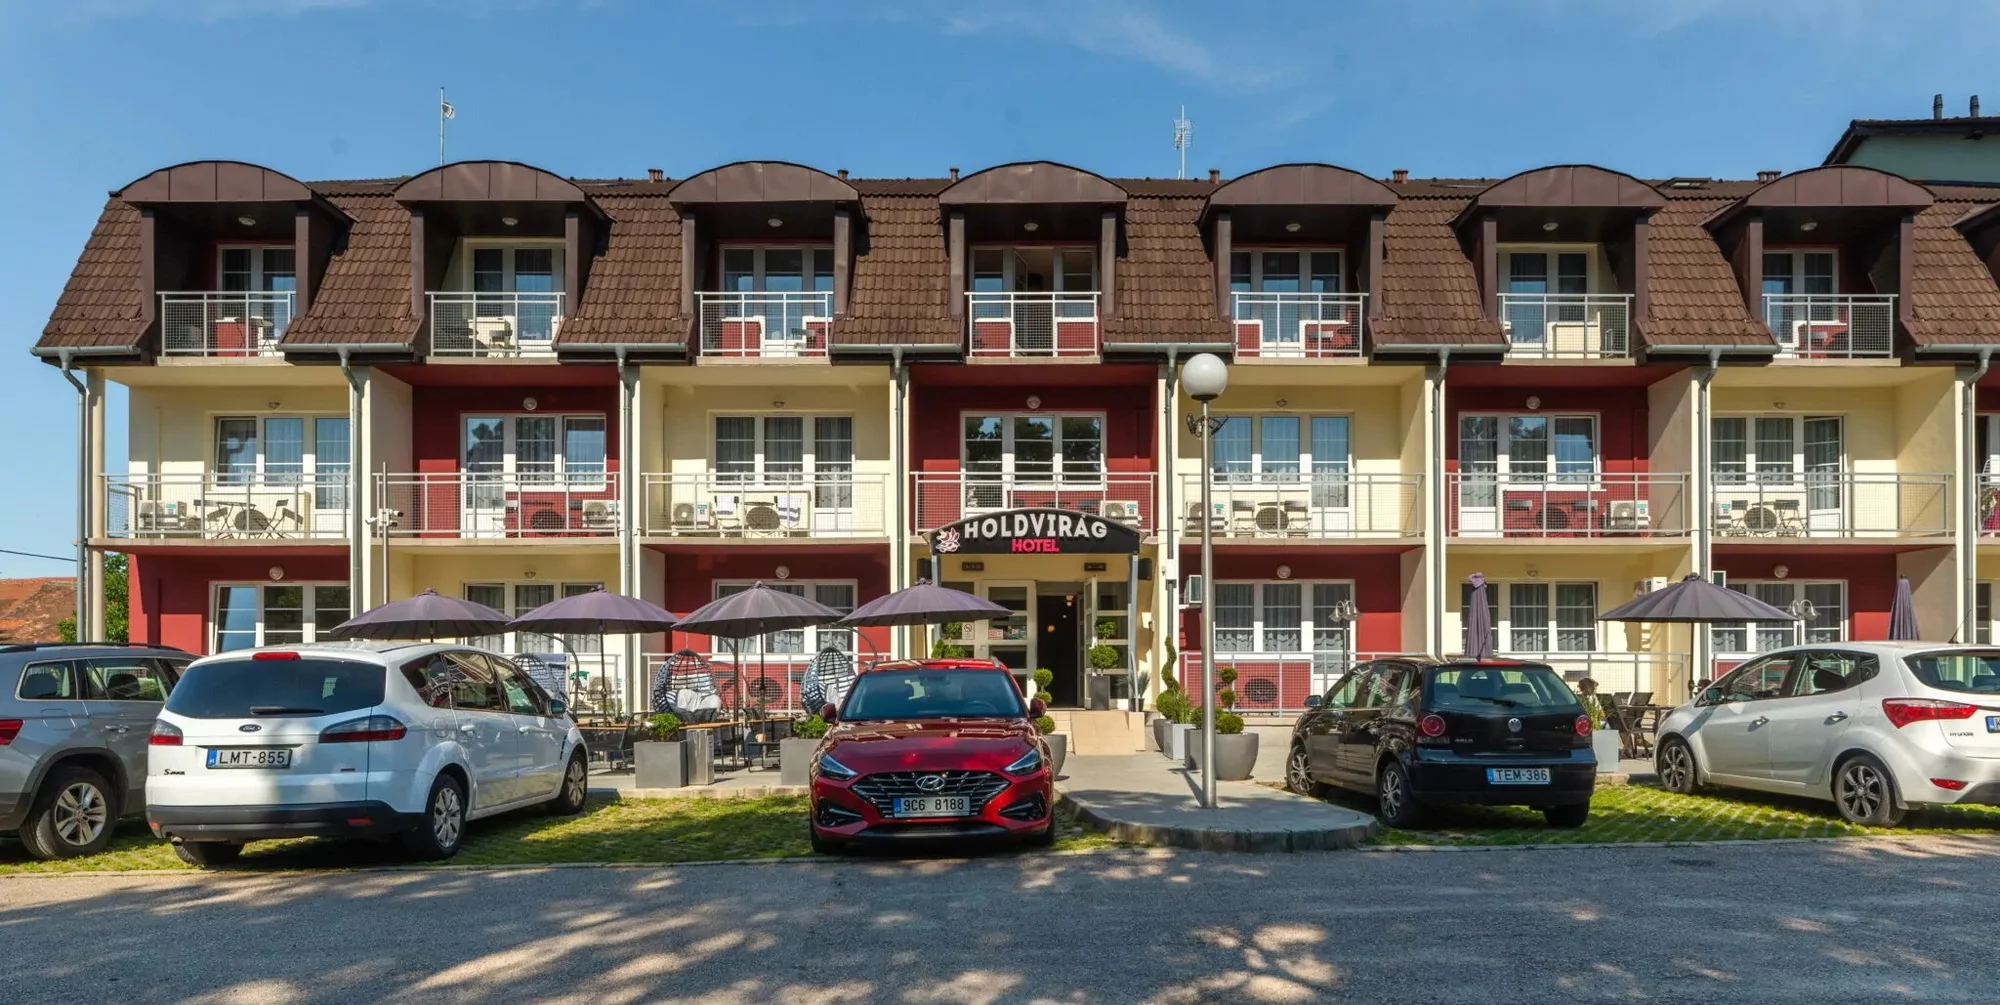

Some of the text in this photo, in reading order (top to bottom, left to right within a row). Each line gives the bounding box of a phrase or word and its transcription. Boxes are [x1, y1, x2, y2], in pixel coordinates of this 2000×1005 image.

[964, 513, 1107, 538] HOLDVIRÁG
[1011, 539, 1060, 552] HOTEL
[219, 751, 285, 764] LMT-855
[1495, 769, 1548, 781] TEM-386
[903, 798, 964, 811] 9C6 8188
